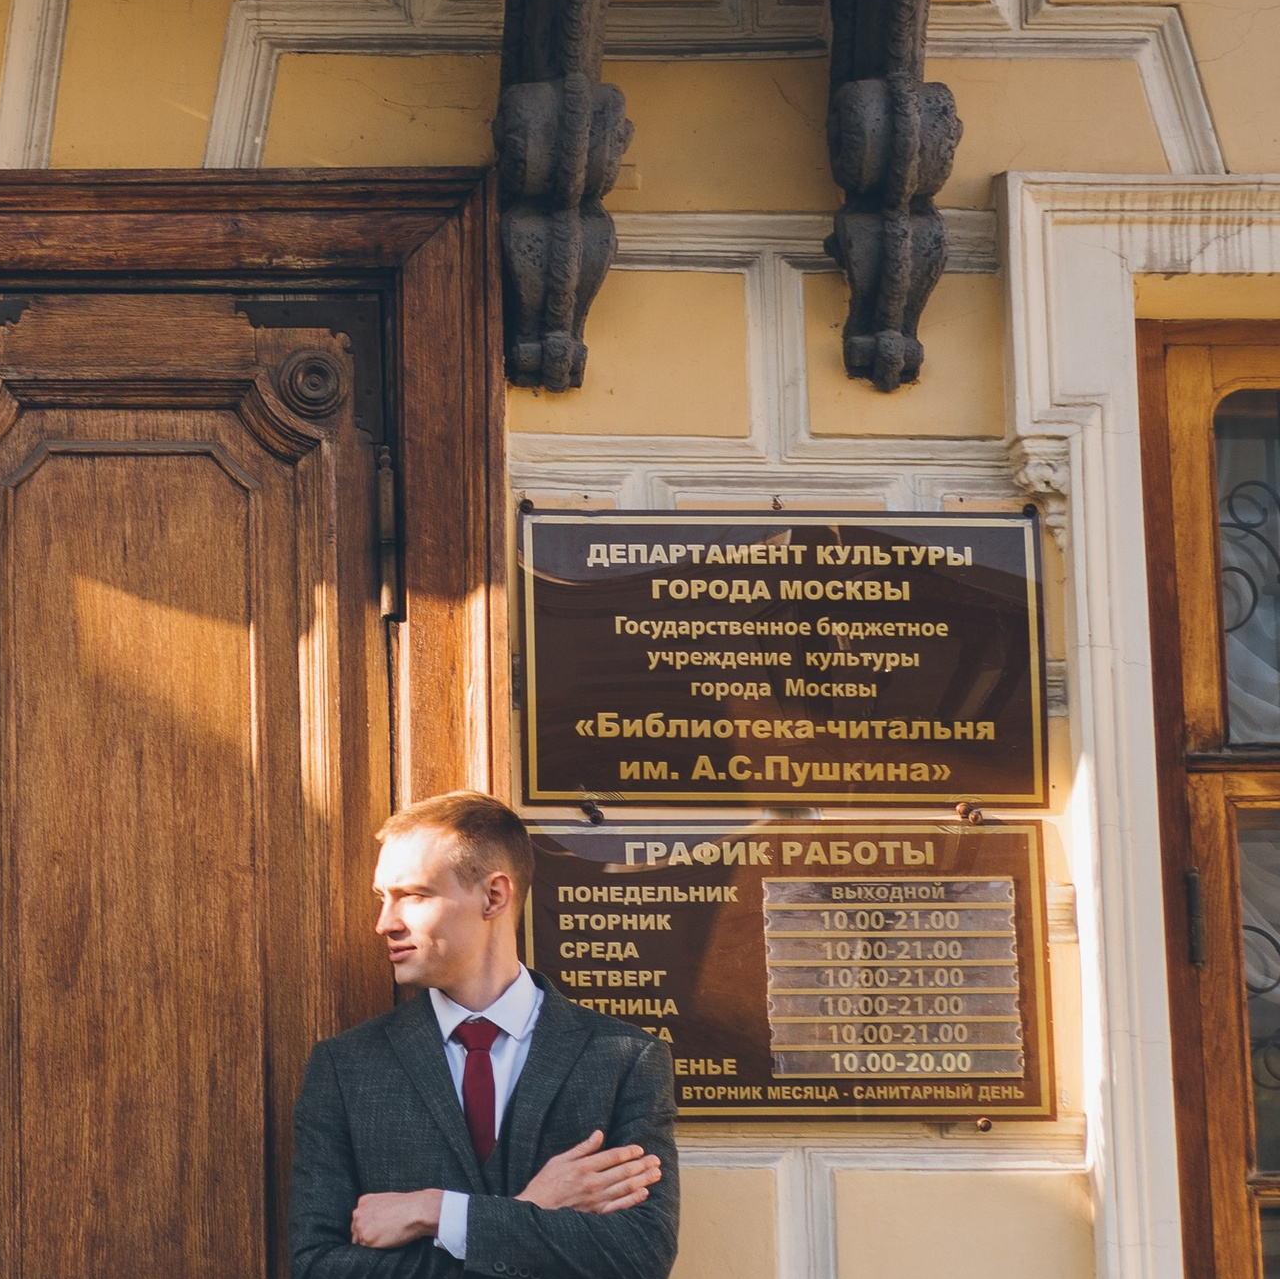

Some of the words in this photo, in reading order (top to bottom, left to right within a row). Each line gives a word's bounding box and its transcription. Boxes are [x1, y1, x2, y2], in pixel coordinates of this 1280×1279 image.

[587, 544, 807, 567] ДЕПАРТАМЕНТ
[817, 546, 972, 566] КУЛЬТУРЫ
[652, 579, 771, 603] ГОРОДА
[780, 580, 910, 601] МОСКВЫ
[615, 616, 811, 640] Государственное
[817, 617, 948, 640] бюджетное
[647, 651, 792, 670] учреждение
[806, 652, 920, 672] культуры
[691, 682, 772, 701] города
[785, 678, 878, 698] Москвы
[575, 712, 996, 740] «Библиотека-читальня
[620, 761, 680, 780] им.
[691, 755, 952, 788] А.С.Пушкина»
[625, 842, 772, 866] ГРАФИК
[782, 841, 935, 866] РАБОТЫ
[558, 886, 739, 905] ПОНЕДЕЛЬНИК
[559, 914, 672, 930] ВТОРНИК
[820, 910, 960, 930] 10.00-21.00
[560, 942, 640, 962] СРЕДА
[823, 940, 963, 960] 10.00-21.00
[561, 970, 667, 988] ЧЕТВЕРГ
[824, 968, 964, 988] 10.00-21.00
[568, 998, 679, 1018] ЯТНИЦА
[824, 996, 964, 1016] 10.00-21.00
[829, 1024, 968, 1044] 10.00-21.00
[831, 1052, 972, 1072] 10.00-20.00
[682, 1086, 763, 1100] ВТОРНИК
[767, 1086, 839, 1102] МЕСЯЦА
[853, 1083, 973, 1100] САНИТАРНЫЙ
[978, 1086, 1024, 1102] ДЕНЬ
